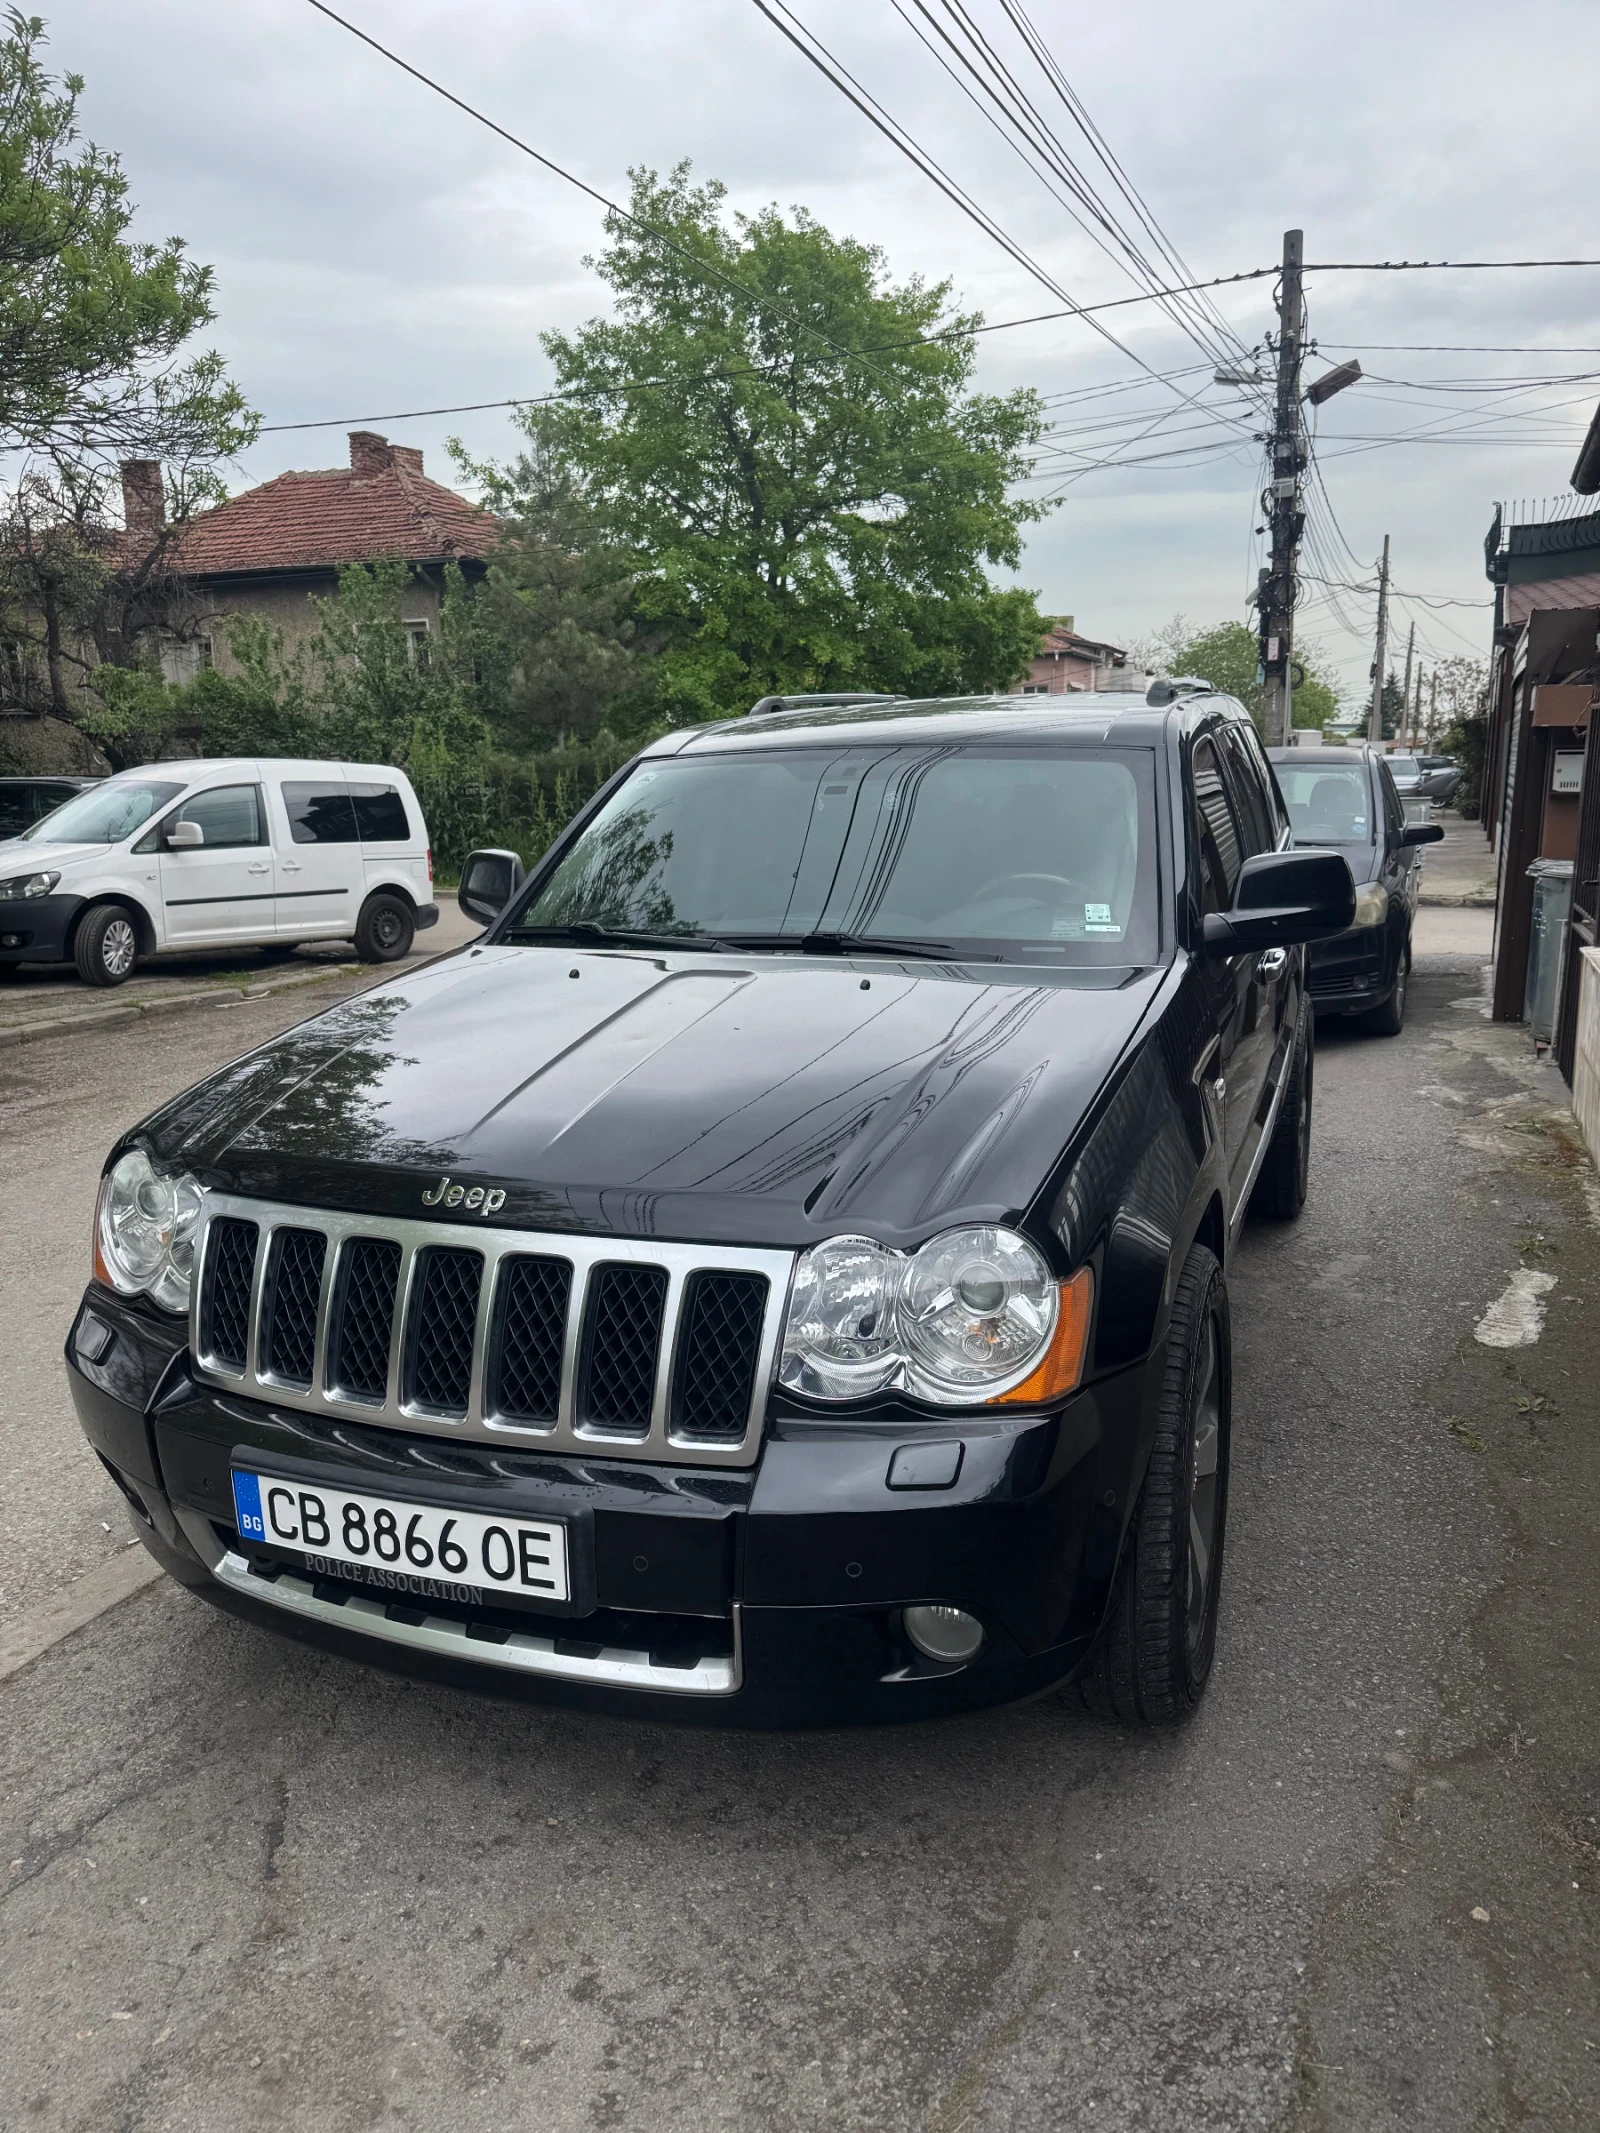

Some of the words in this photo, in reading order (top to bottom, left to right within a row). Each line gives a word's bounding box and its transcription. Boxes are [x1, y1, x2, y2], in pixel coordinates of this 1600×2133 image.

[421, 1177, 506, 1217] Jeep
[242, 1513, 262, 1532] BG
[267, 1487, 331, 1547] CB
[342, 1502, 468, 1574] 8866
[481, 1525, 555, 1590] OE
[304, 1553, 363, 1583] POLICE
[366, 1567, 483, 1606] ASSOCIATION
